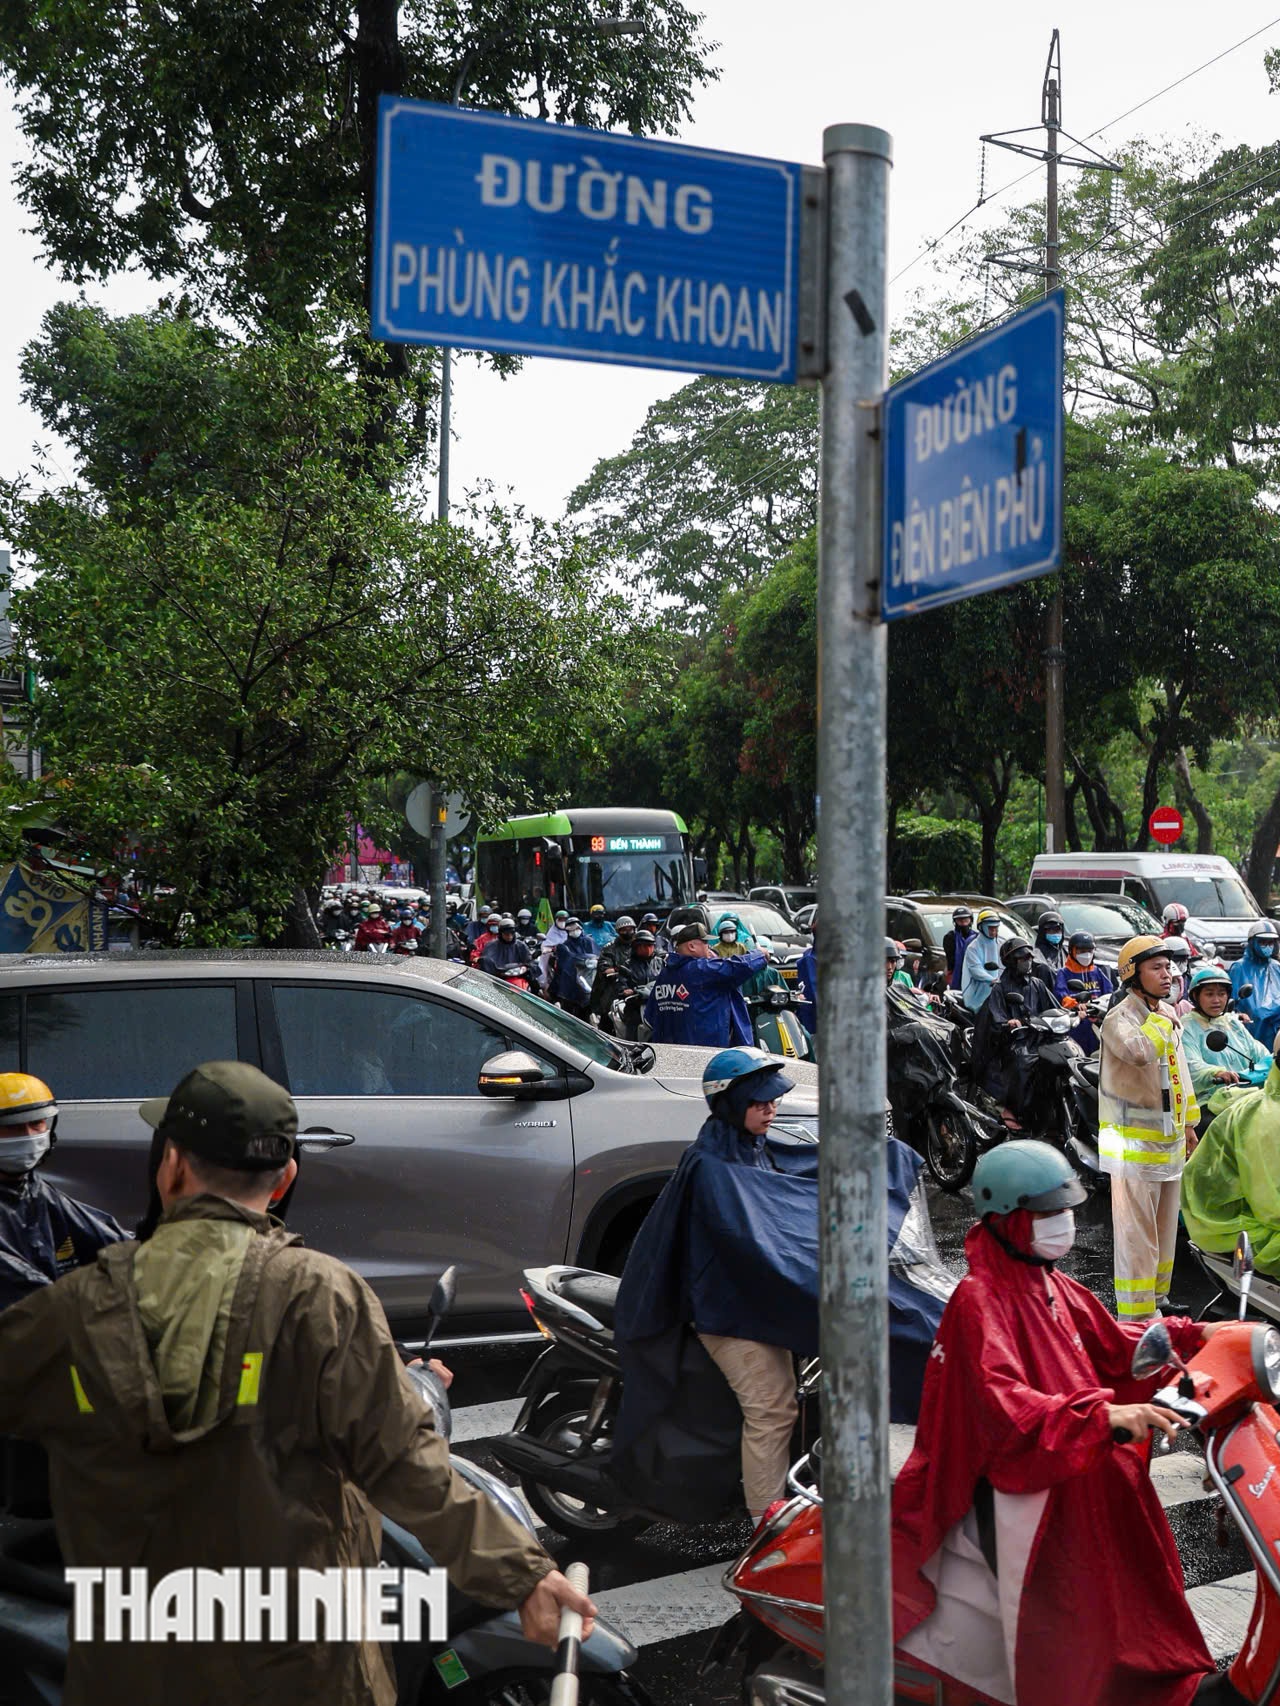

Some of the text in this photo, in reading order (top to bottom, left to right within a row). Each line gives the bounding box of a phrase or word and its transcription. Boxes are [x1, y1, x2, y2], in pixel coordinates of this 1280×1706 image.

[475, 154, 713, 235] ĐƯỜNG
[391, 228, 782, 353] PHÙNG KHẮC KHOAN
[914, 364, 1017, 463] ĐƯỜNG
[940, 475, 990, 571] BIÊN
[995, 437, 1046, 552] PHỦ
[610, 837, 661, 850] BẾN THÀNH
